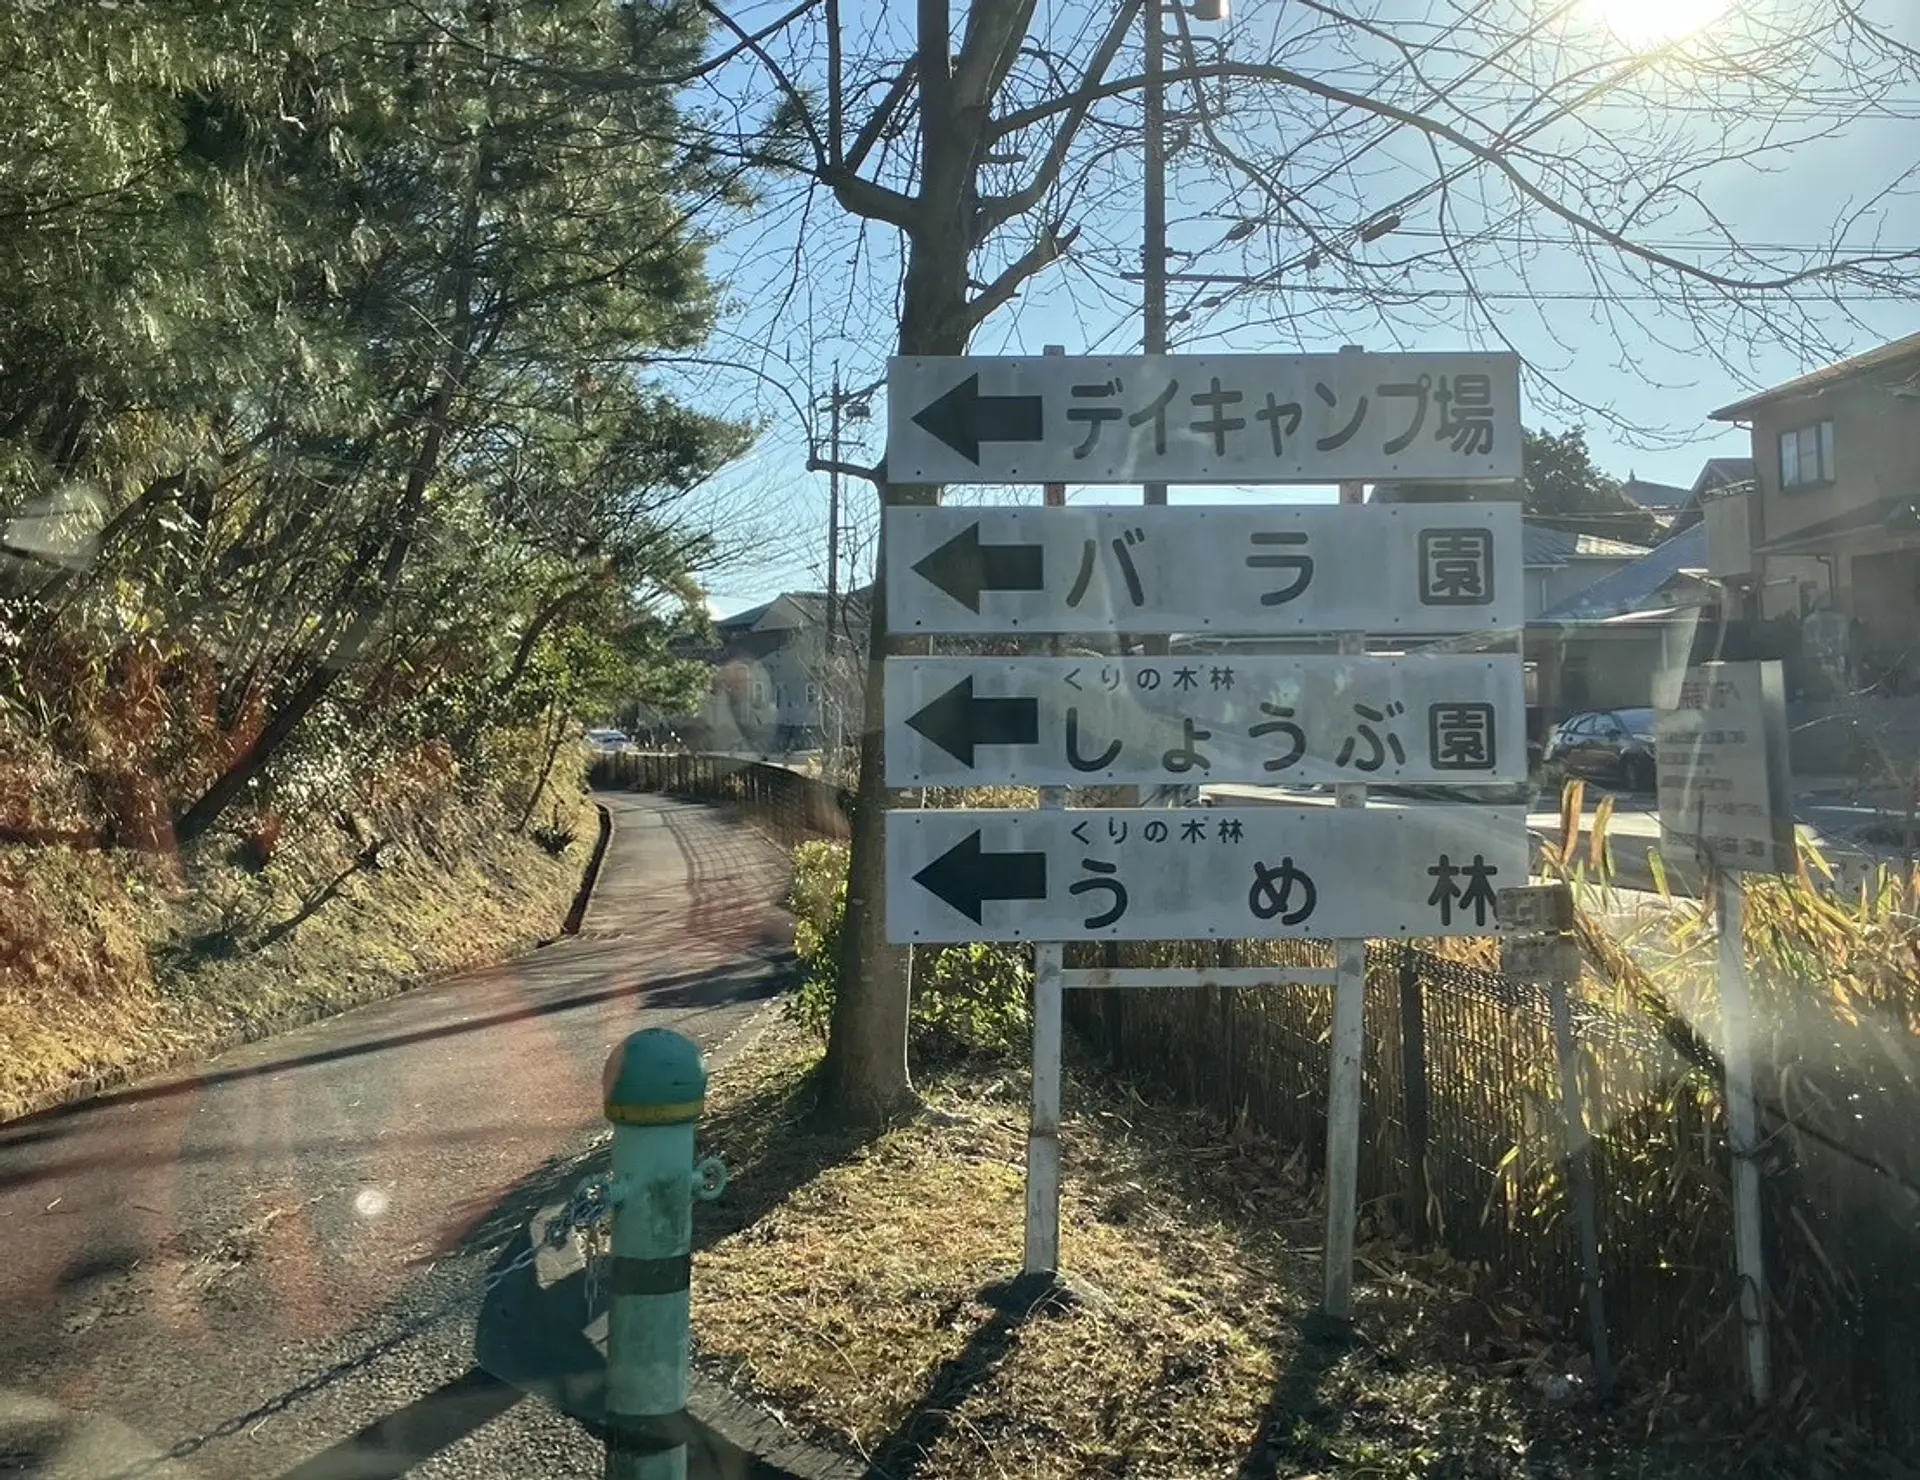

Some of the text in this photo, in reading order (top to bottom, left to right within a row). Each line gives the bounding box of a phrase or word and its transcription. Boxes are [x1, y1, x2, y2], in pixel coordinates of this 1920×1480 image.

[1066, 372, 1494, 460] デイキャンプ場
[1065, 526, 1495, 608] バラ園
[1063, 665, 1236, 692] くりの木林
[1065, 700, 1497, 773] しょうぶ園
[1070, 818, 1245, 846] くりの木林
[1068, 853, 1499, 930] うめ林
